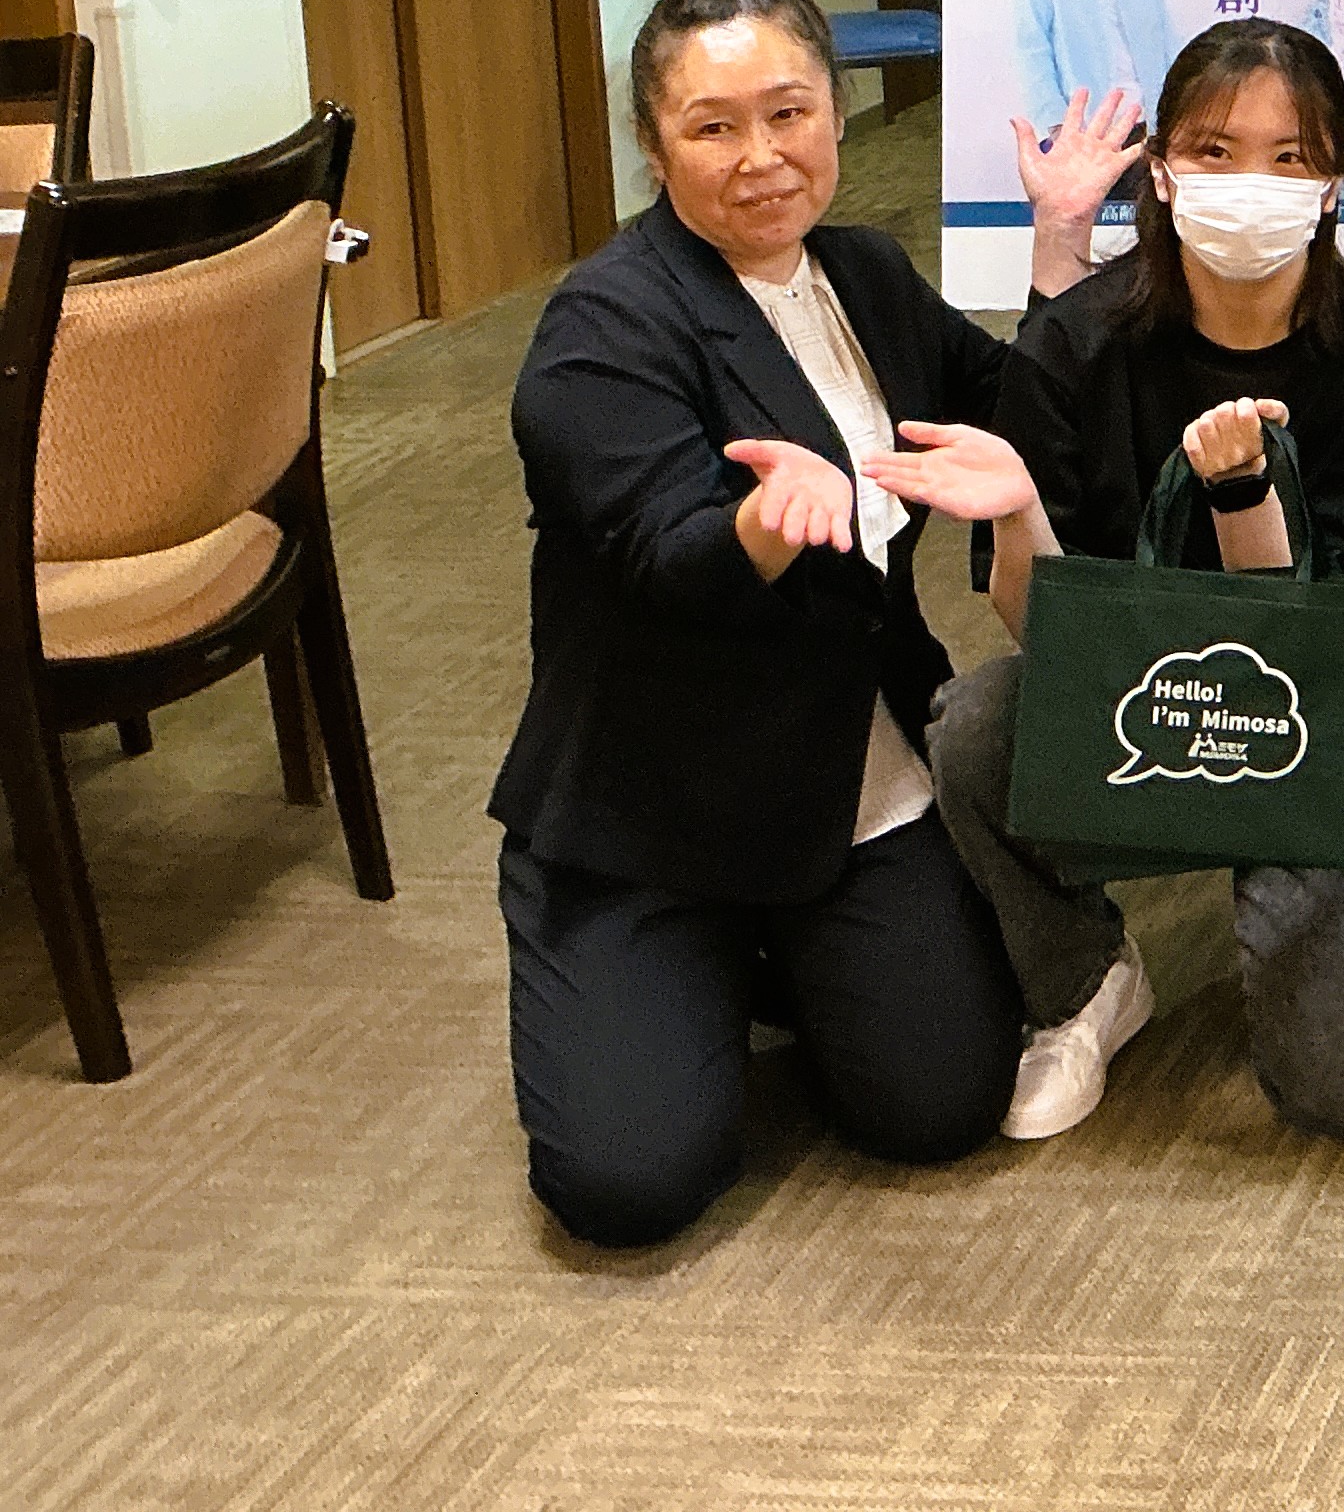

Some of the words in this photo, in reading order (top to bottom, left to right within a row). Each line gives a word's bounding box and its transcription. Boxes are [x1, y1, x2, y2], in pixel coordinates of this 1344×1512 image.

[1154, 679, 1223, 702] Hello!
[1152, 706, 1190, 727] I'm
[1202, 709, 1289, 734] Mimosa
